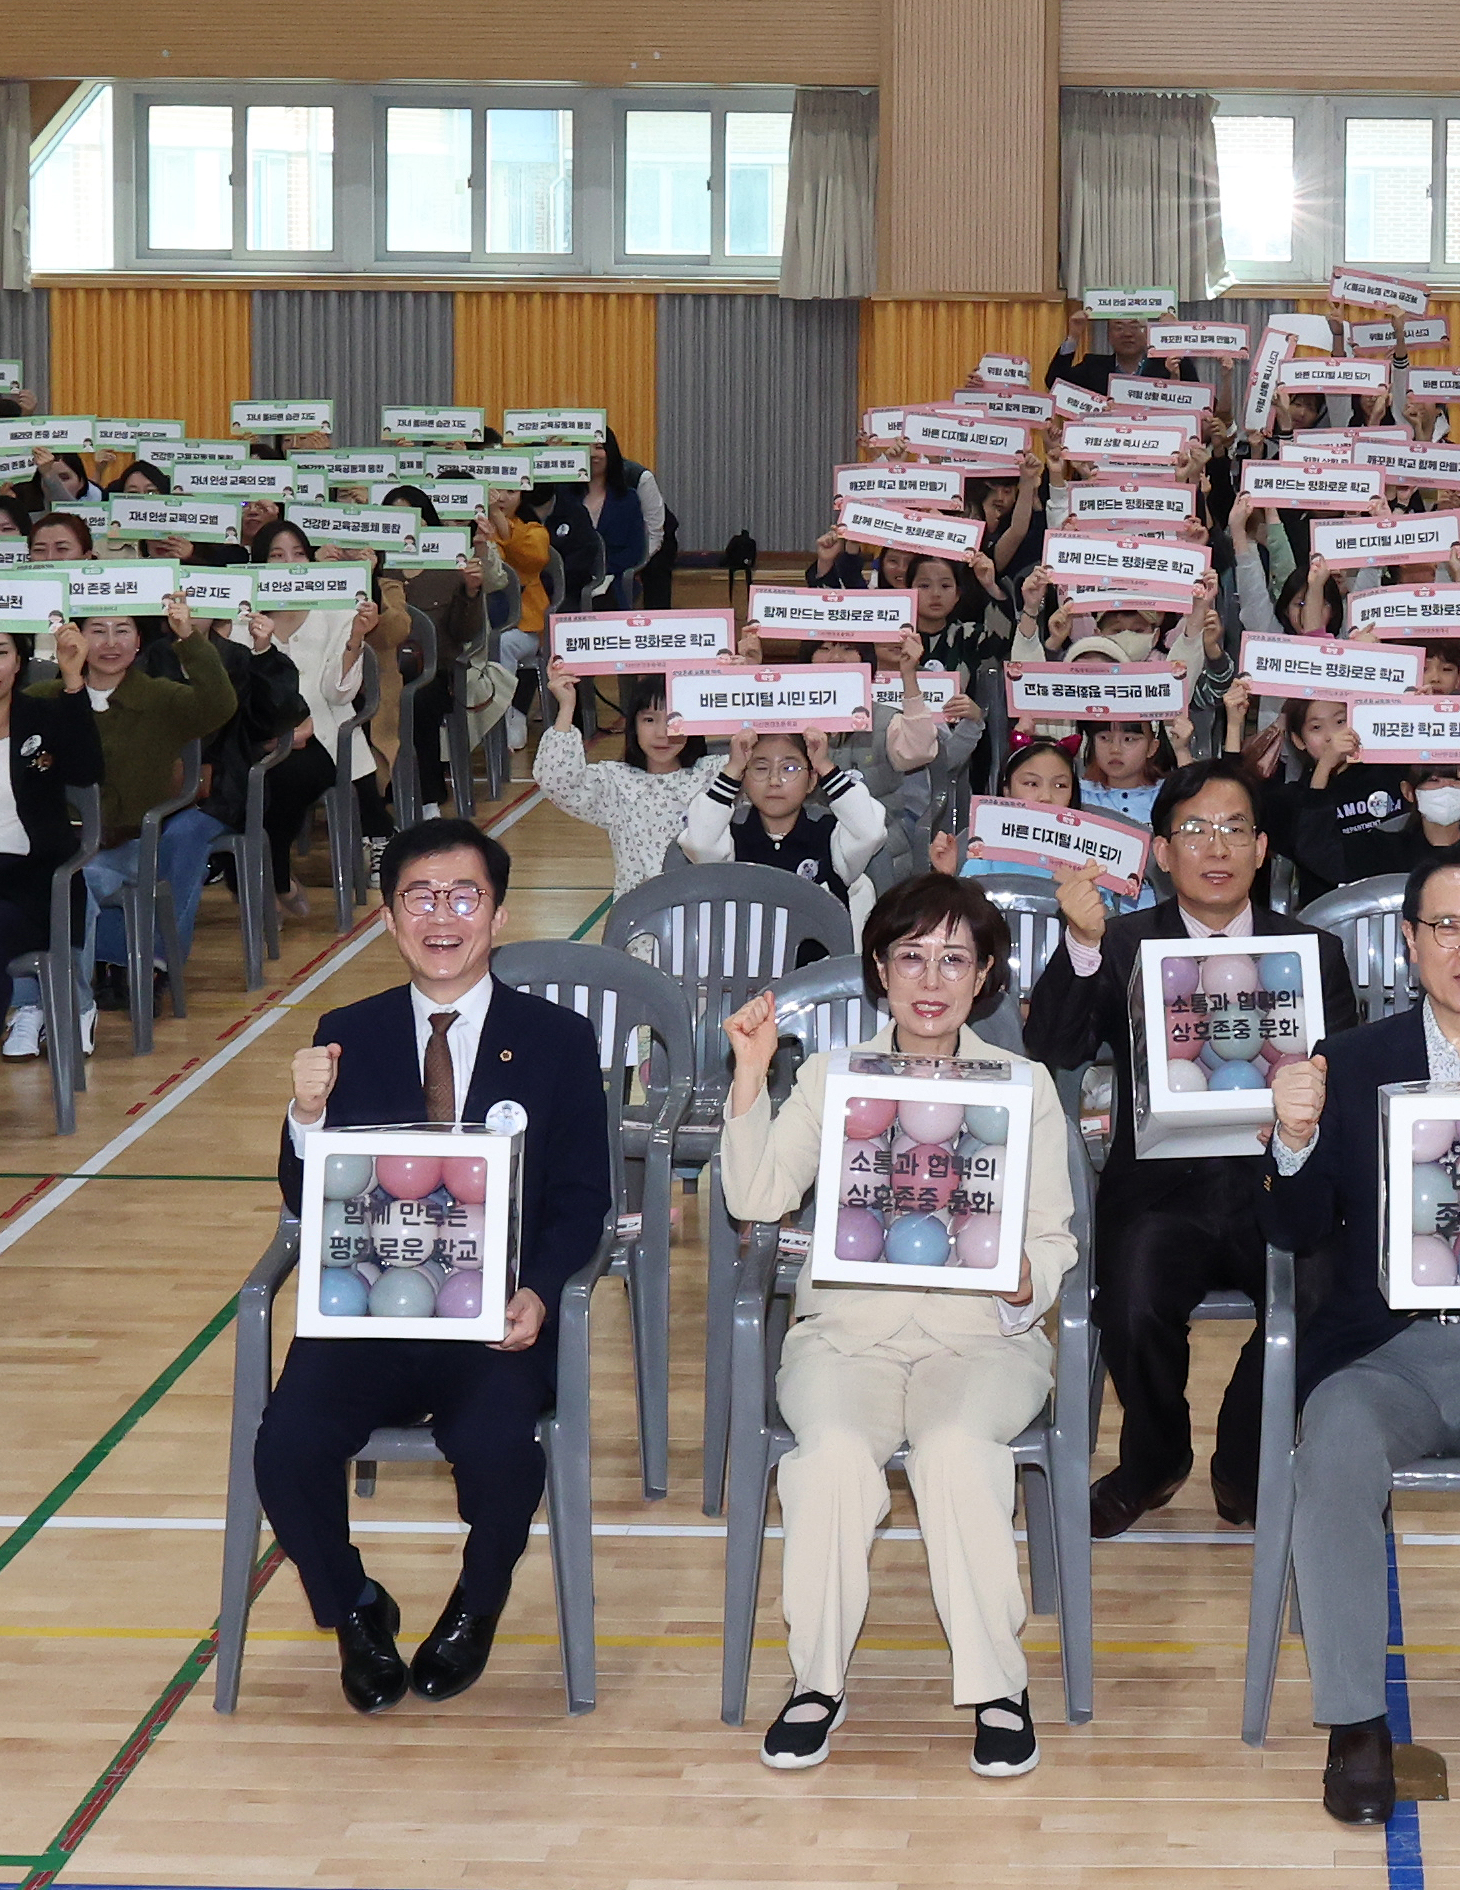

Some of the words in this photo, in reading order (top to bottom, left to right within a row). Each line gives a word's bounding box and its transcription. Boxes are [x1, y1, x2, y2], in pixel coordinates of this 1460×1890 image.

[1336, 537, 1356, 550] 바른
[1360, 535, 1391, 548] 디지털
[1395, 533, 1414, 545] 시민
[1418, 531, 1438, 544] 되기
[566, 636, 590, 652] 함께
[594, 636, 630, 651] 만드는
[635, 634, 686, 649] 평화로운
[691, 633, 715, 647] 학교
[1257, 656, 1281, 672] 함께
[1285, 659, 1321, 676] 만드는
[1326, 663, 1375, 681] 평화로운
[1380, 667, 1404, 683] 학교
[701, 693, 727, 708] 바른
[732, 691, 773, 708] 디지털
[778, 691, 804, 706] 시민
[810, 690, 836, 706] 되기
[1373, 722, 1414, 738] 깨끗한
[1418, 722, 1444, 738] 학교
[1002, 822, 1029, 840] 바른
[1032, 825, 1071, 849] 디지털
[1073, 835, 1098, 857] 시민
[1098, 844, 1122, 866] 되기
[1171, 990, 1230, 1013] 소통과
[1237, 990, 1297, 1013] 협력의
[1171, 1018, 1252, 1042] 상호존중
[1258, 1018, 1299, 1042] 문화
[849, 1150, 919, 1182] 소통과
[928, 1150, 996, 1182] 협력의
[847, 1181, 940, 1214] 상호존중
[947, 1181, 995, 1214] 문화
[343, 1199, 391, 1230] 함께
[399, 1199, 468, 1230] 만드는
[328, 1232, 424, 1261] 평화로운
[431, 1232, 478, 1261] 학교
